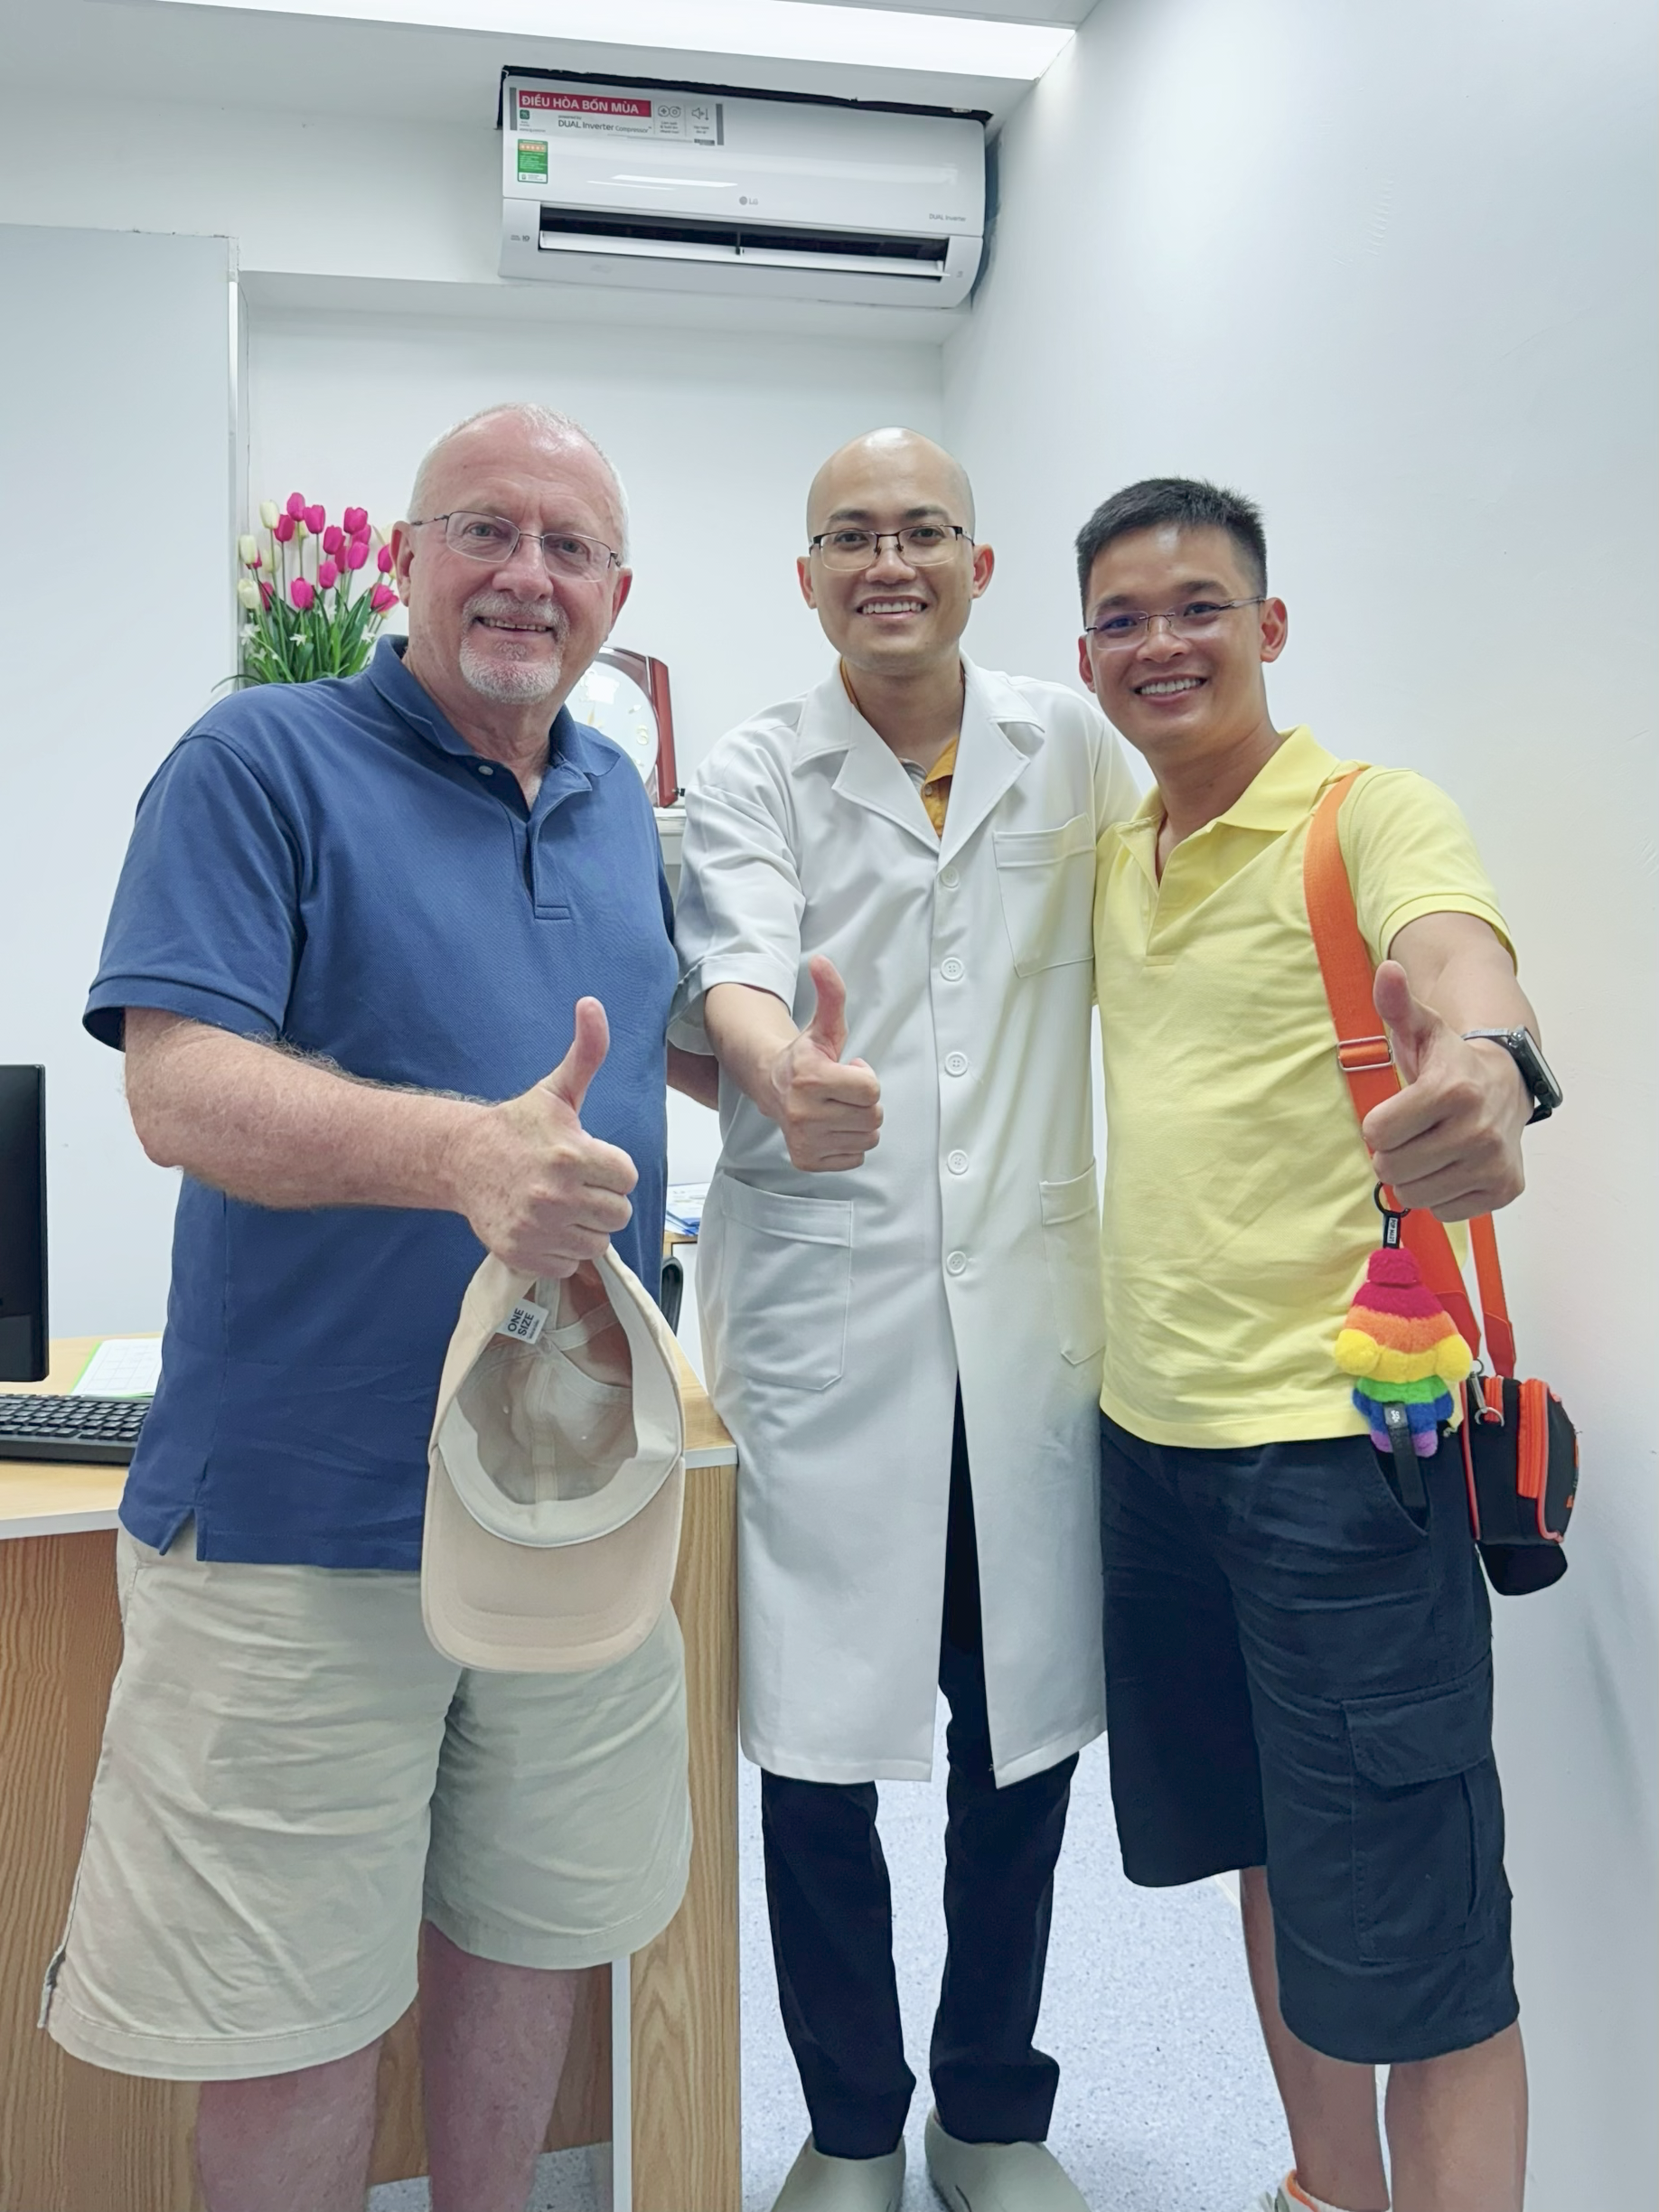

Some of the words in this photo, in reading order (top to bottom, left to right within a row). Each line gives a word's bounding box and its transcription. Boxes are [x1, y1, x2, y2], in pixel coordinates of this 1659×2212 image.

[553, 96, 580, 109] HÒA
[582, 98, 608, 112] BỐN
[611, 101, 639, 115] MÙA
[558, 119, 582, 129] DUAL
[582, 122, 614, 132] Inverter
[507, 1308, 525, 1333] ONE
[517, 1312, 535, 1336] SIZE
